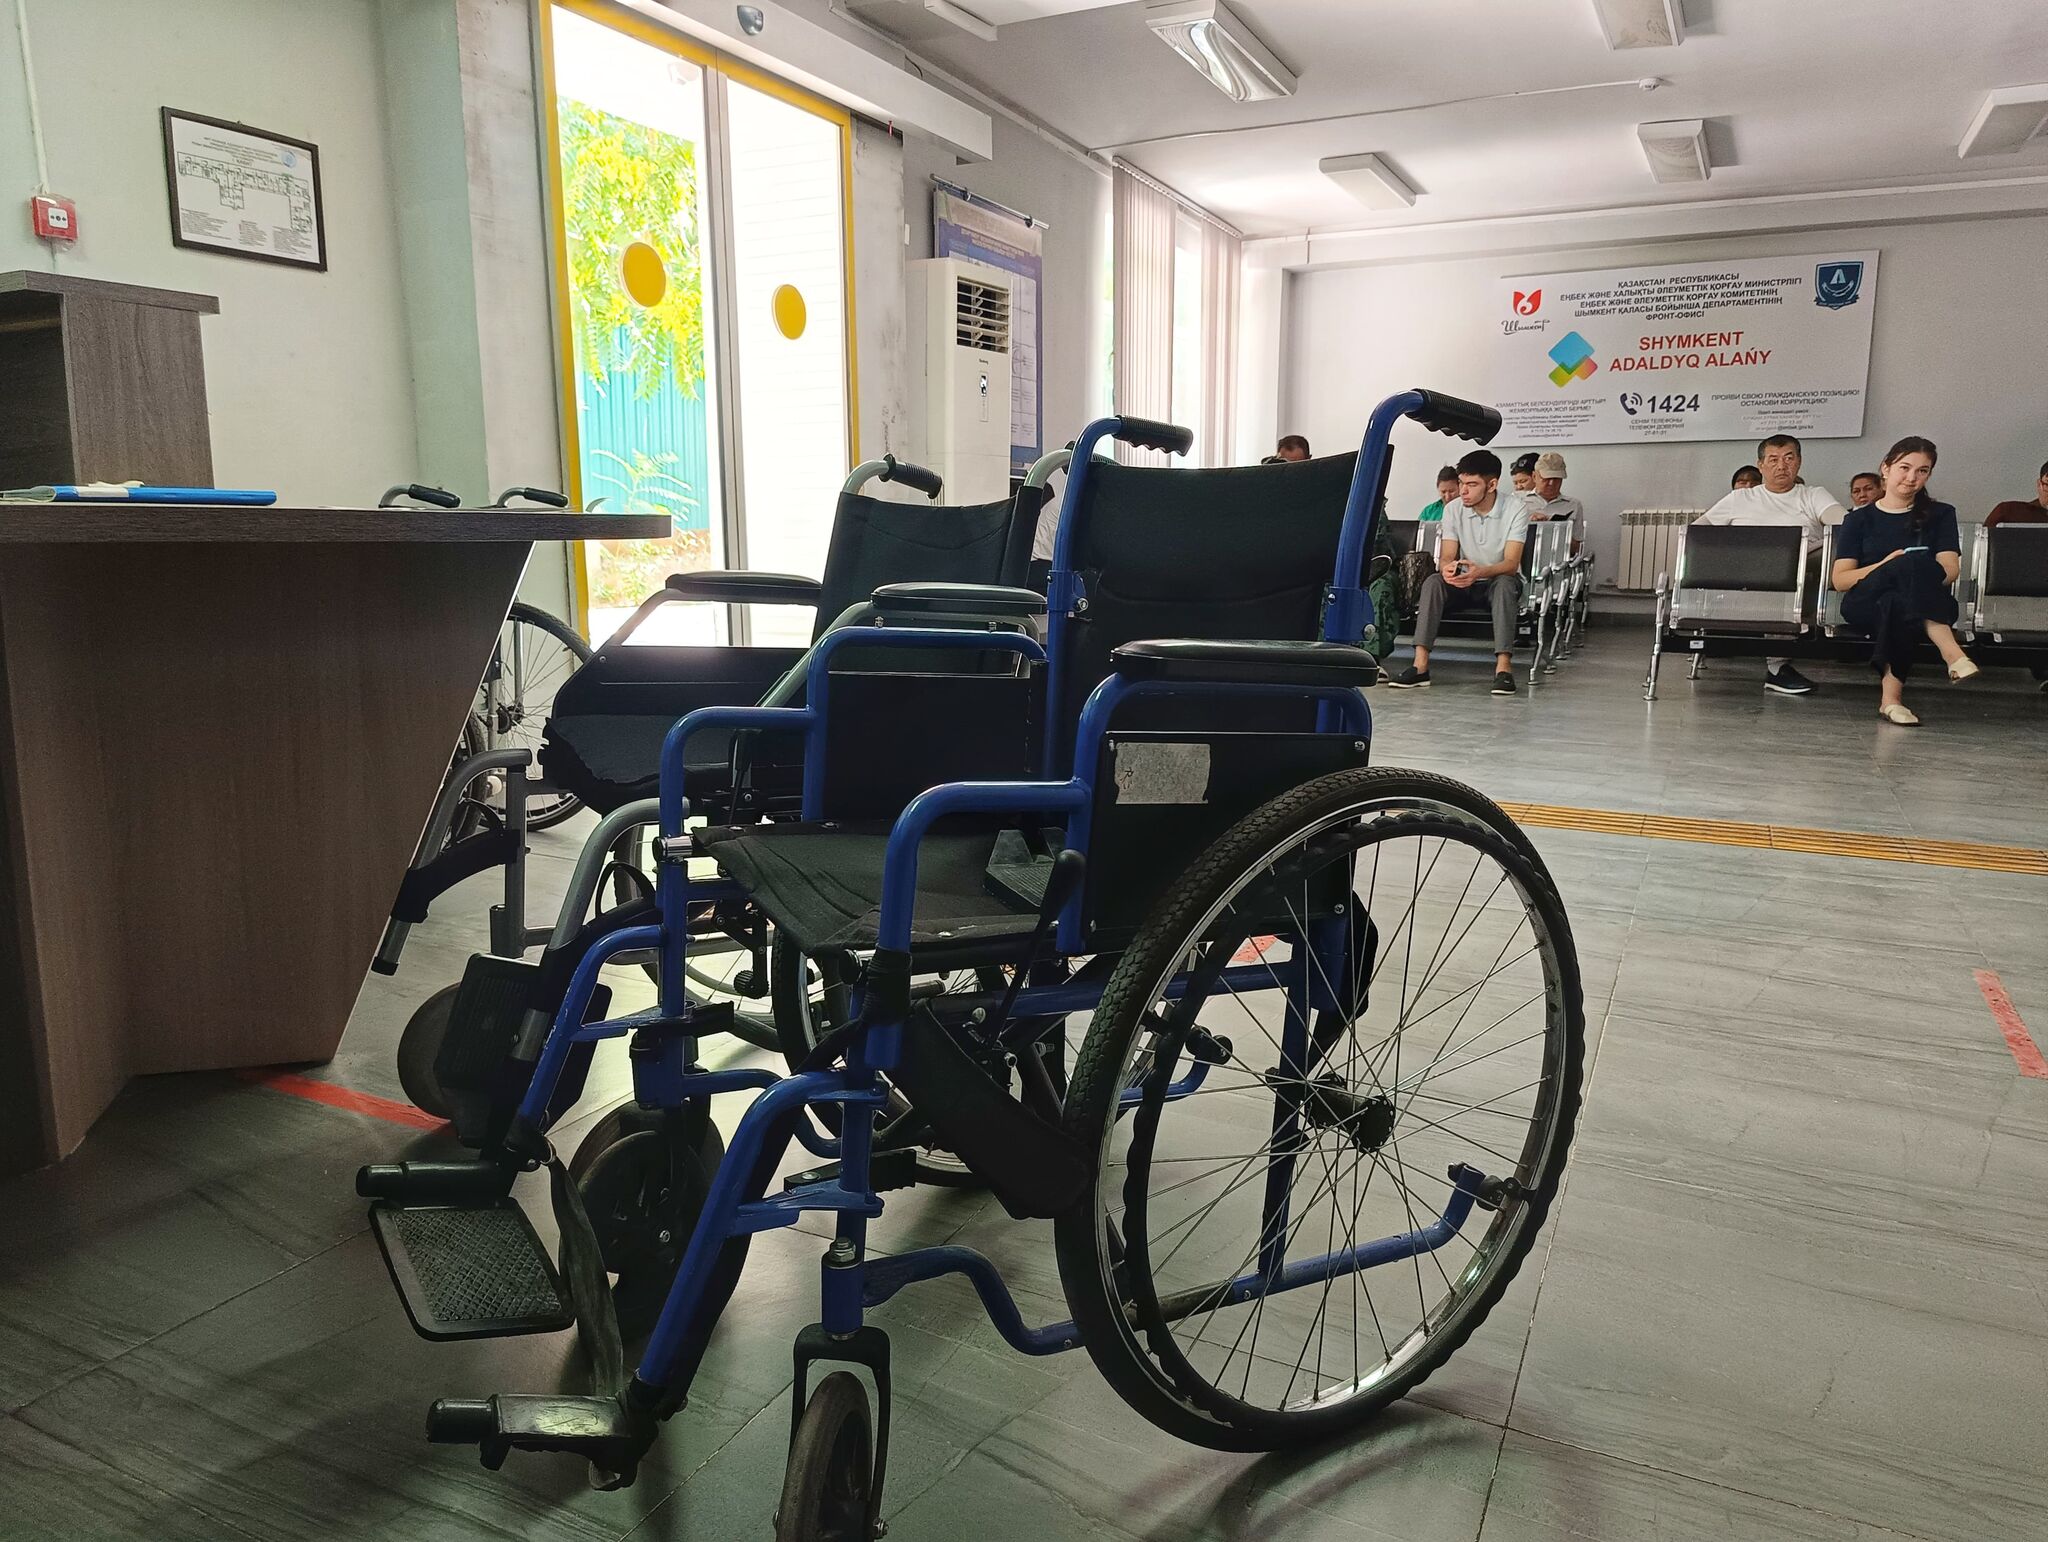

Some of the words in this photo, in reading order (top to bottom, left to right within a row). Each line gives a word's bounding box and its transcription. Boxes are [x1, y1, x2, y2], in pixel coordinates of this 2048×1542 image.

[1617, 278, 1666, 289] ҚАЗАҚСТАН
[1669, 273, 1740, 285] РЕСПУБЛИКАСЫ
[1744, 277, 1802, 289] МИНИСТРЛІГІ
[1574, 307, 1617, 317] ШЫМКЕНТ
[1618, 304, 1653, 315] ҚАЛАСЫ
[1655, 301, 1701, 312] БОЙЫНША
[1645, 310, 1705, 321] ФРОНТ-ОФИСІ
[1639, 331, 1744, 351] SHYMKENT
[1609, 353, 1700, 372] ADALDYQ
[1705, 346, 1772, 367] ALAŃY
[1647, 393, 1700, 414] 1424
